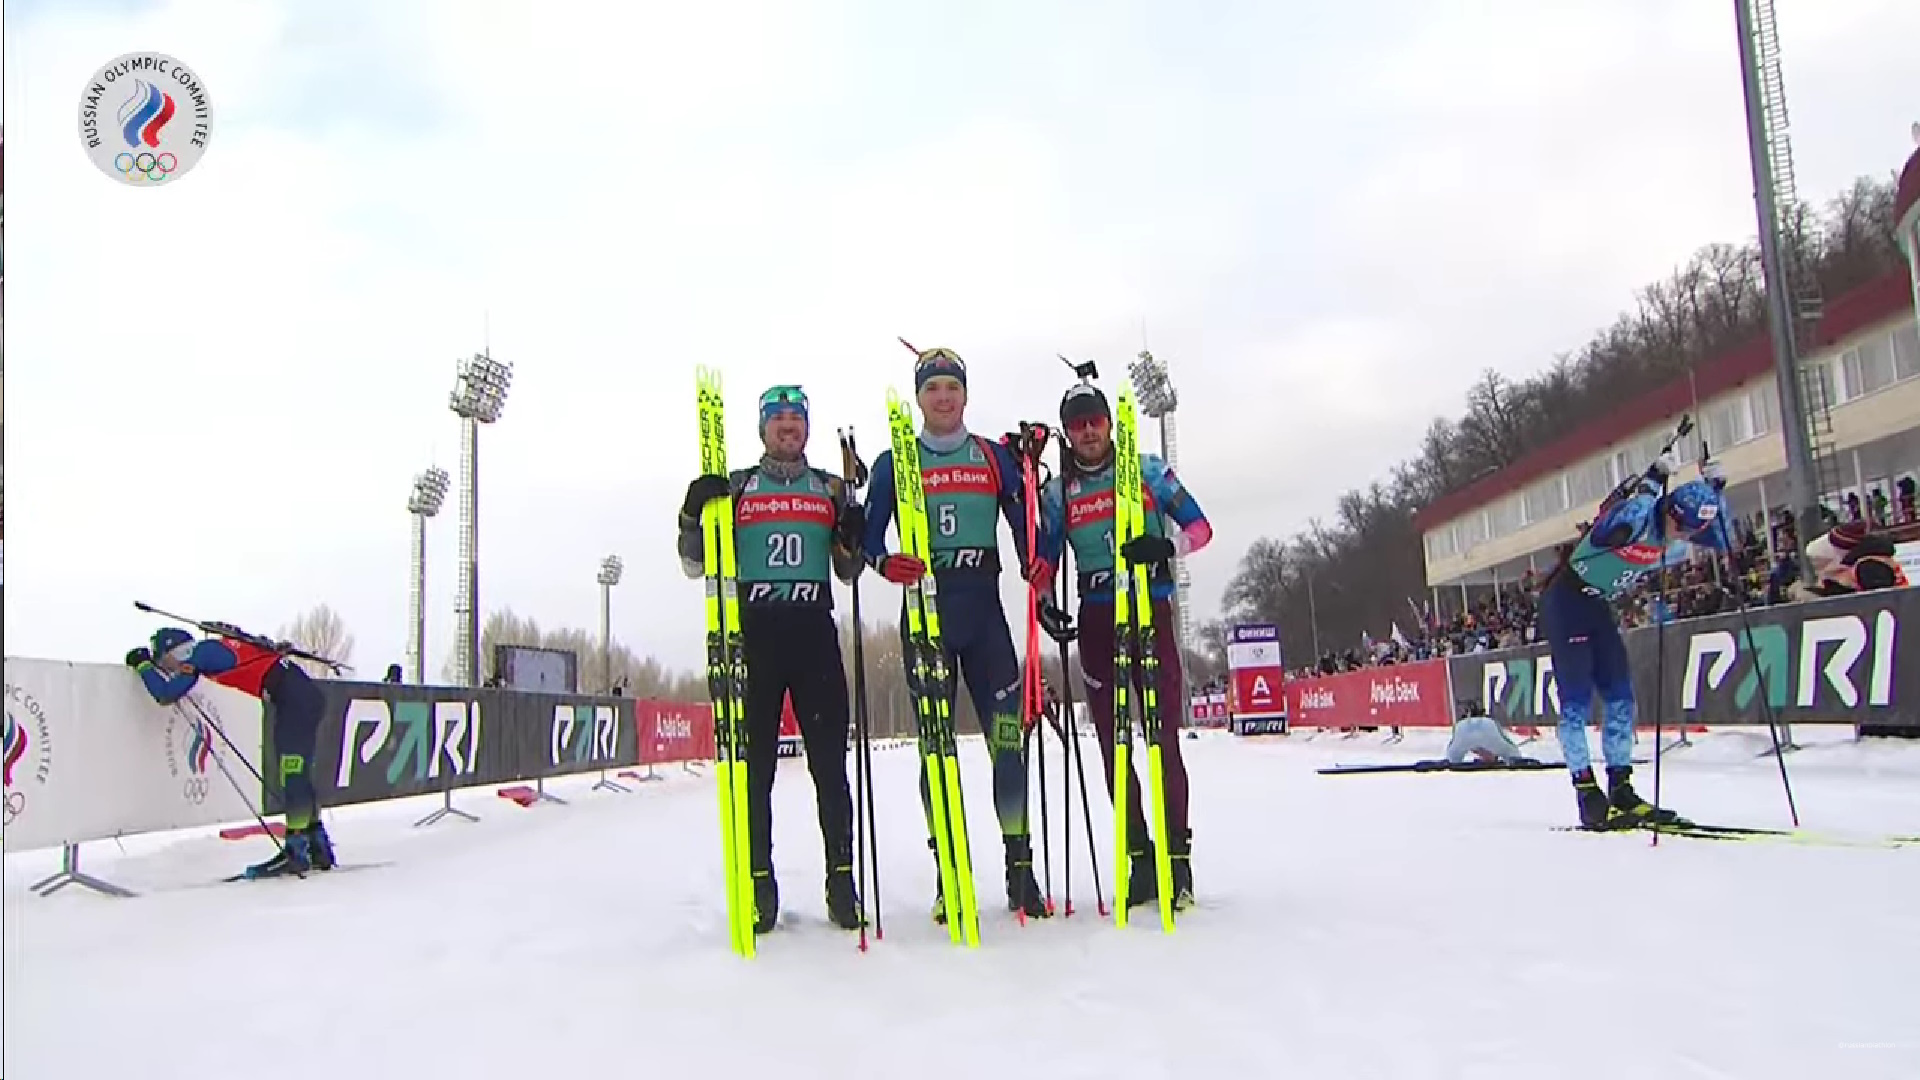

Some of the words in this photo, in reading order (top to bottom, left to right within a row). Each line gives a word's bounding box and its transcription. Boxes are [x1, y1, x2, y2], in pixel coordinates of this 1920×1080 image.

[700, 408, 713, 476] SCHER
[714, 412, 727, 478] SCHER
[891, 426, 908, 504] FISCHER
[1116, 420, 1127, 498] FISCHER
[1128, 432, 1141, 504] FISCHER
[740, 498, 790, 514] Альфа
[791, 497, 829, 514] Банк
[952, 468, 988, 484] Банк
[767, 533, 802, 567] 20
[939, 504, 956, 536] 5
[932, 549, 985, 568] ARI
[748, 582, 820, 601] PARI
[1484, 654, 1561, 715] PAR
[1682, 609, 1895, 709] PARI
[337, 698, 479, 787] PARI
[552, 705, 619, 765] PARI
